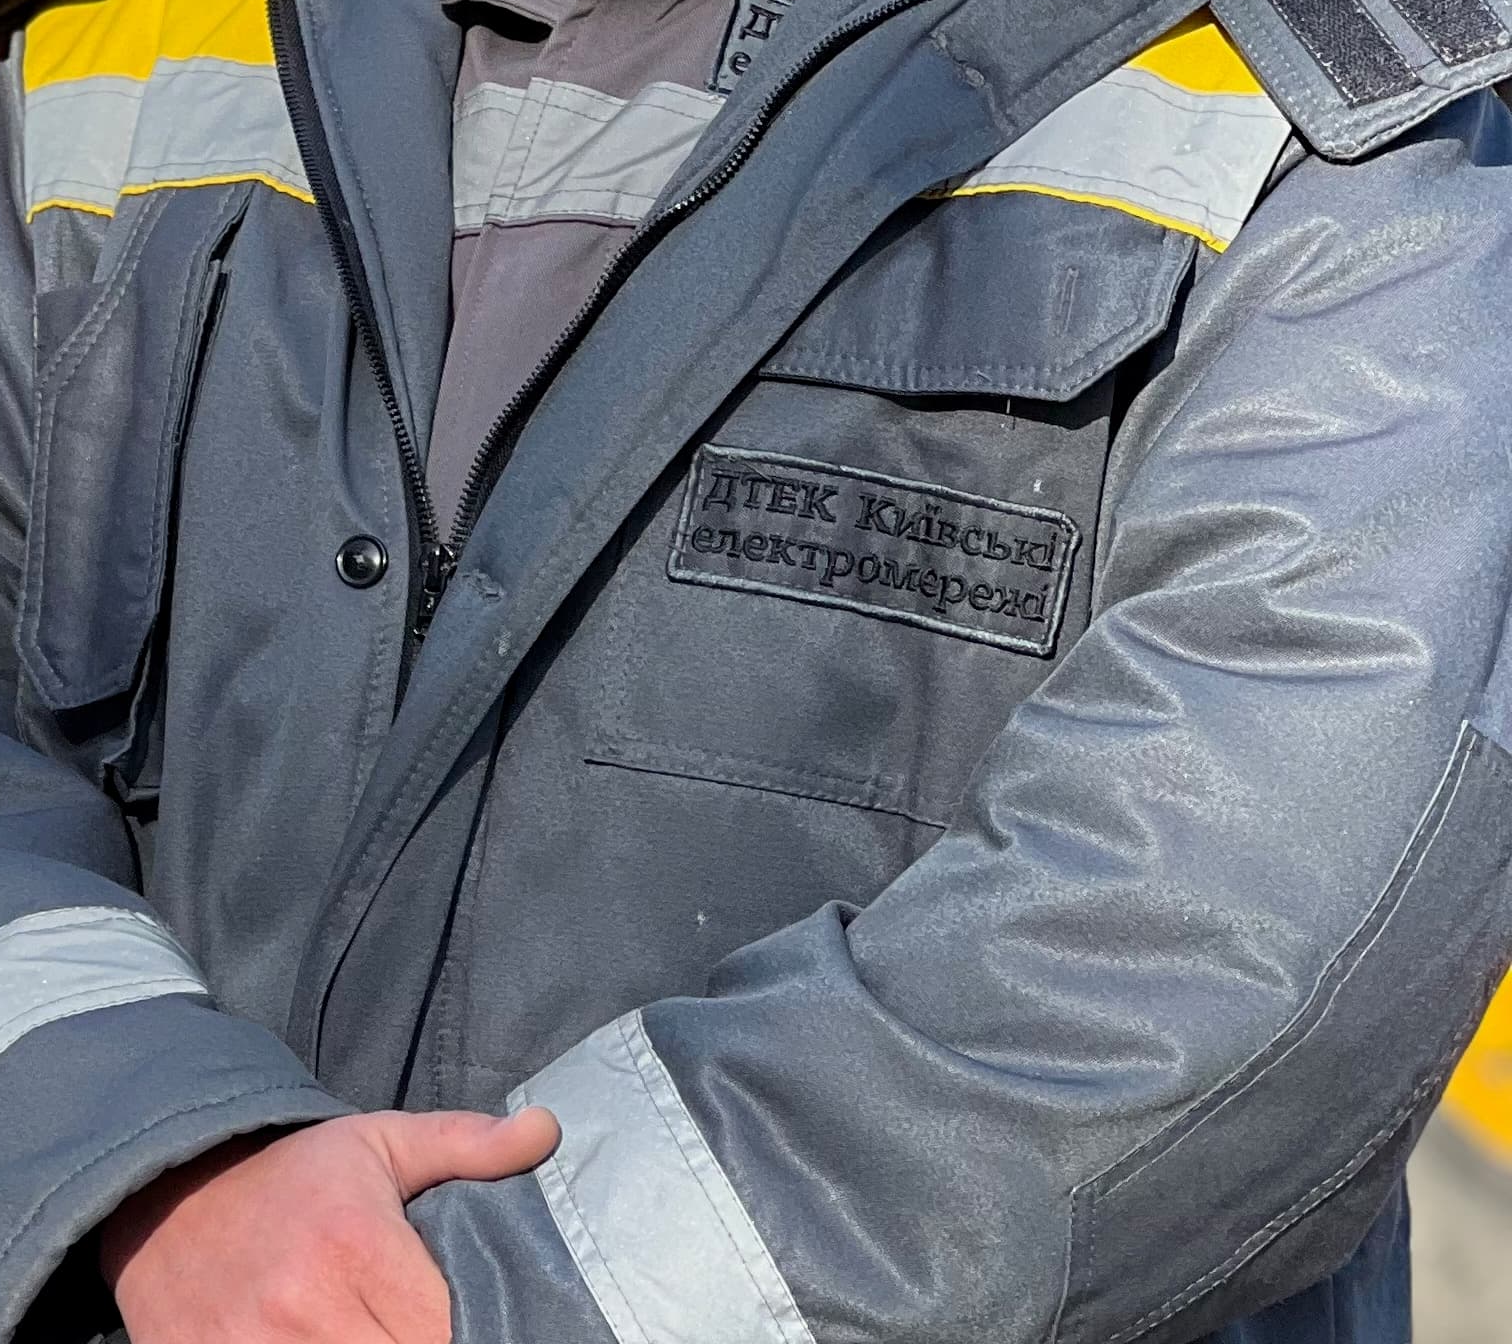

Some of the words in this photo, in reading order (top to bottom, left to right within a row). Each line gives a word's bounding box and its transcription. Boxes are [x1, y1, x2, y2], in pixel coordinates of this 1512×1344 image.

[702, 471, 838, 523] ДТЕК
[855, 490, 1058, 573] Київські
[692, 523, 1049, 623] електромережі
